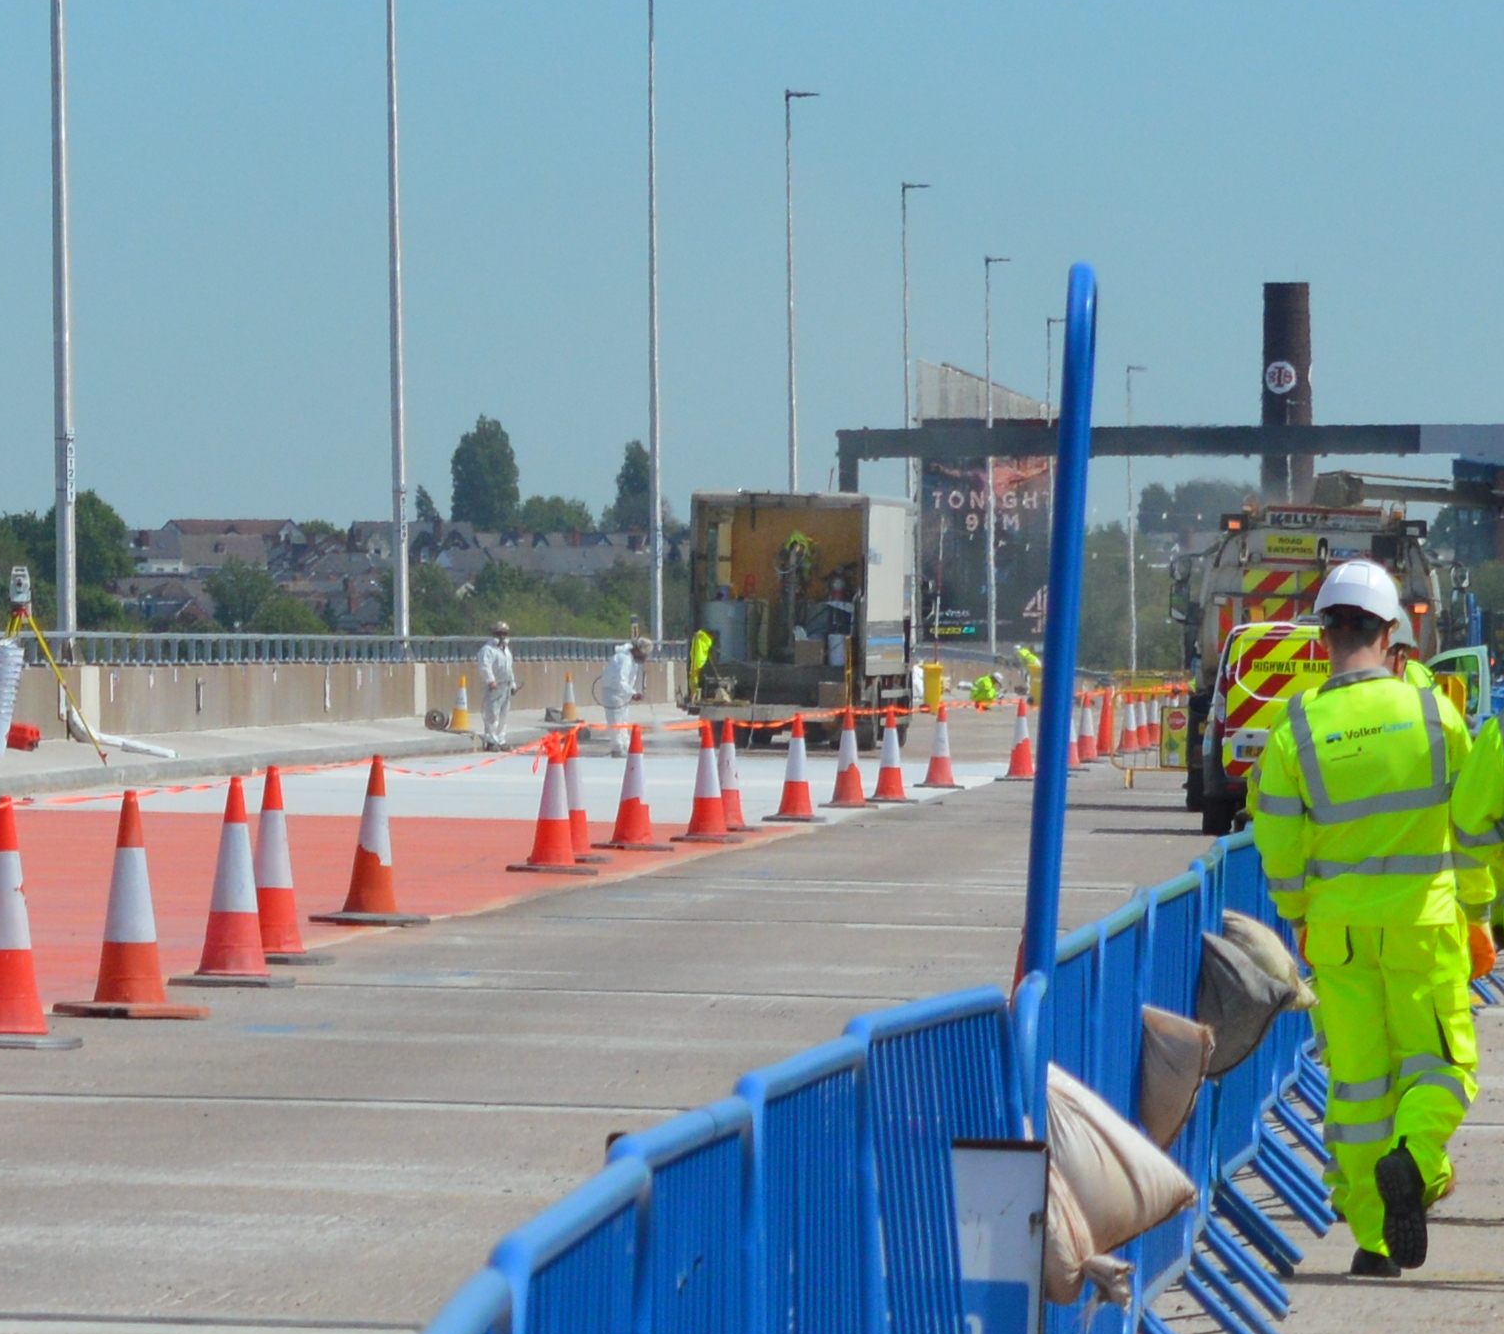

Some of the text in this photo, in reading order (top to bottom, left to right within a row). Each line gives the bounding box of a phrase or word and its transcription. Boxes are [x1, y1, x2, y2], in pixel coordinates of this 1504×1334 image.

[931, 489, 1052, 509] TONGHT
[1278, 537, 1303, 545] ROAD
[1267, 546, 1314, 555] SWEEPING
[1253, 660, 1297, 673] HIGHWAY
